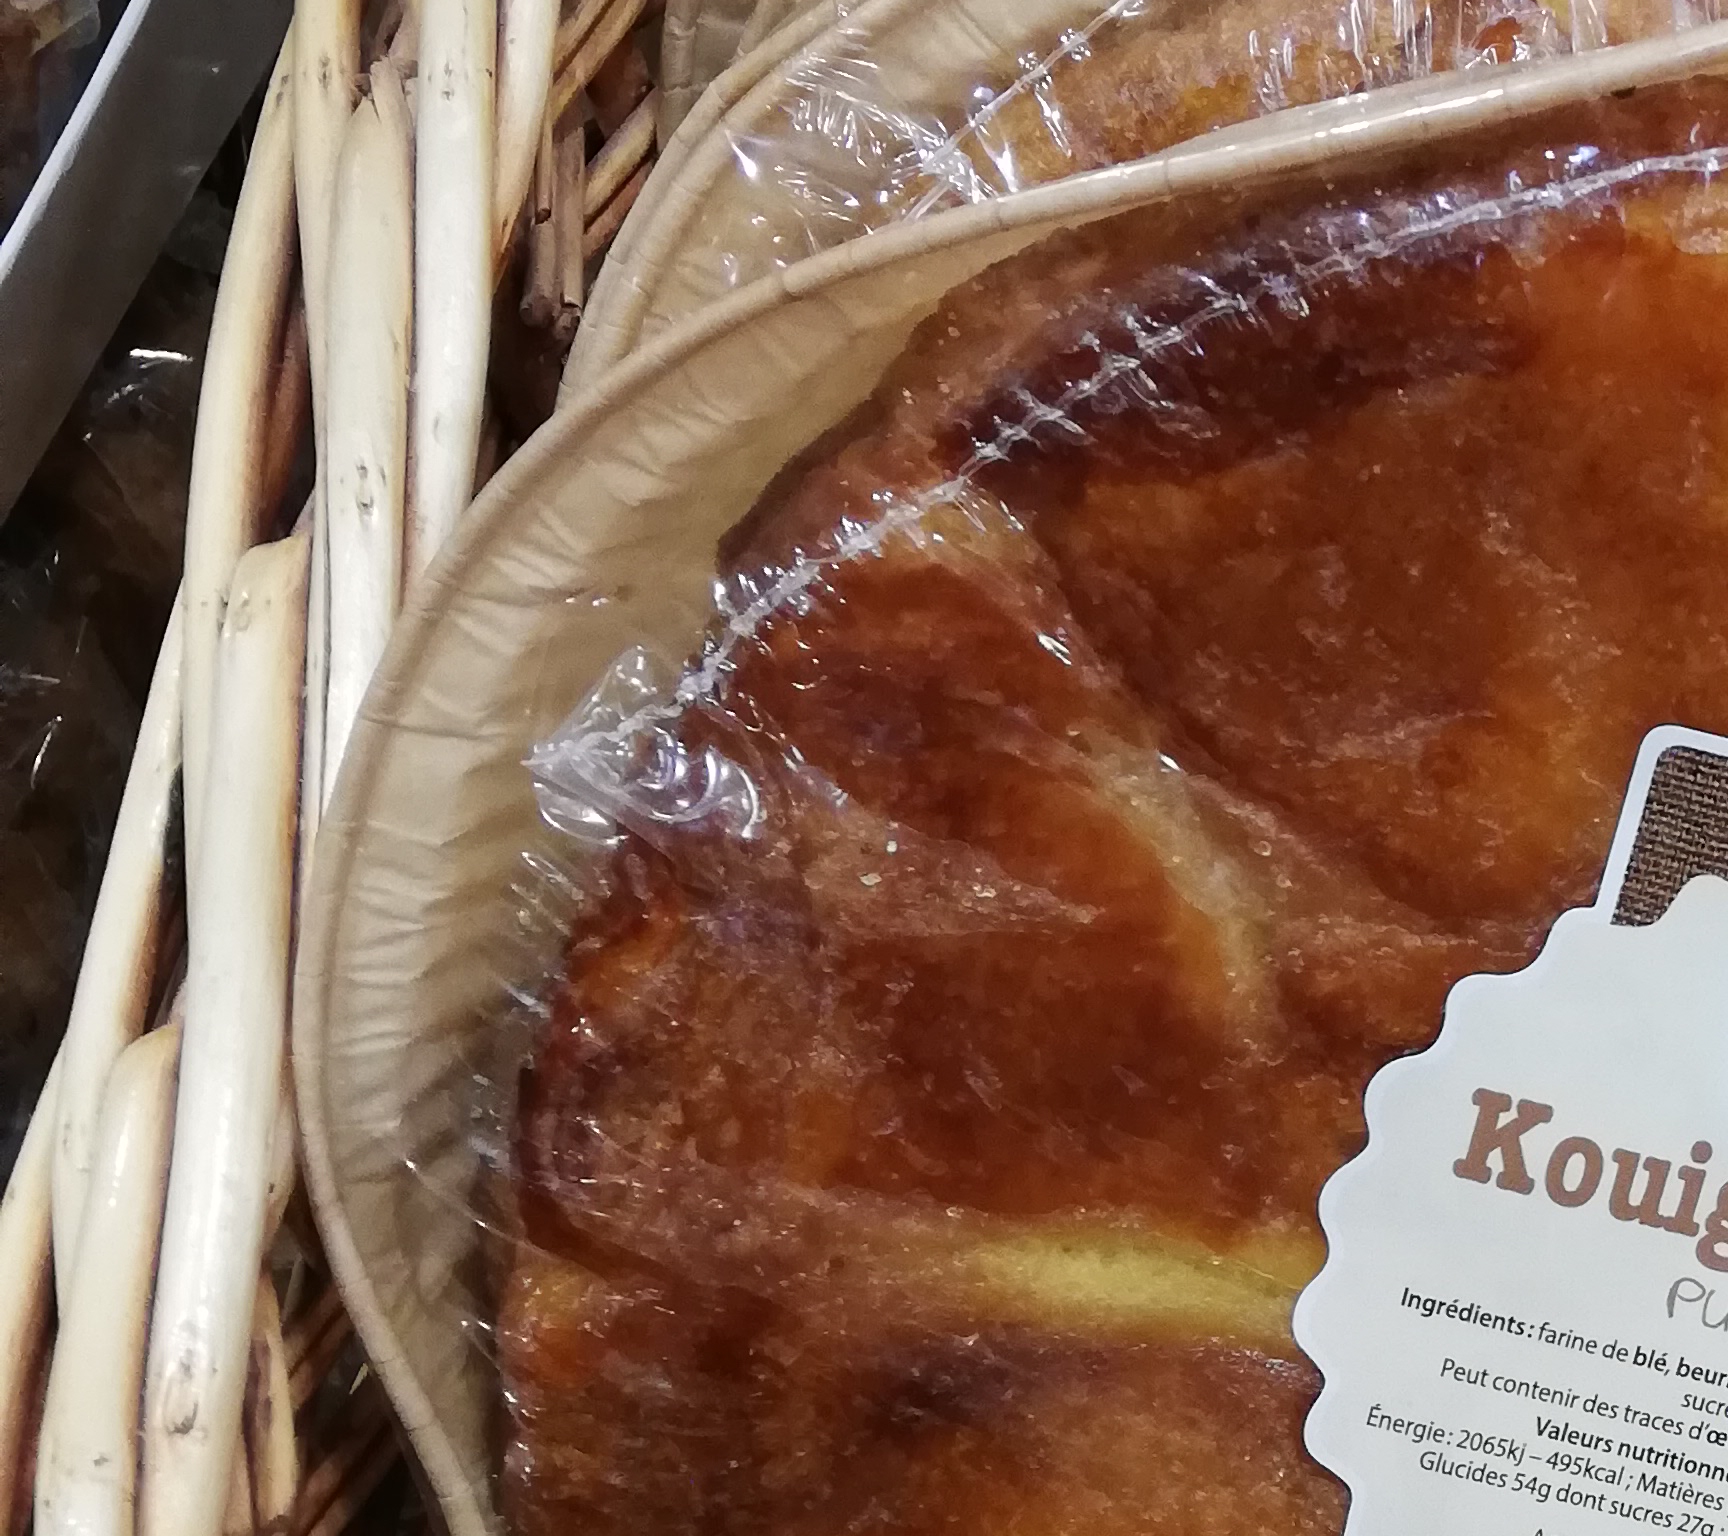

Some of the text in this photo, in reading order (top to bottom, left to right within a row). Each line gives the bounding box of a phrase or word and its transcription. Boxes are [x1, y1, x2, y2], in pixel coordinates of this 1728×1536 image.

[1537, 1320, 1598, 1355] farine
[1601, 1338, 1629, 1362] de
[1631, 1344, 1670, 1377] blé,
[1439, 1356, 1490, 1388] Peut
[1491, 1375, 1580, 1408] contenir
[1581, 1392, 1620, 1419] des
[1623, 1403, 1685, 1436] traces
[1536, 1415, 1614, 1453] Valeurs
[1418, 1450, 1508, 1488] Glucides
[1510, 1471, 1552, 1503] 54g
[1555, 1482, 1607, 1512] dont
[1607, 1499, 1674, 1528] sucres
[1455, 1428, 1527, 1467] 2065kj
[1635, 1471, 1725, 1511] Matières
